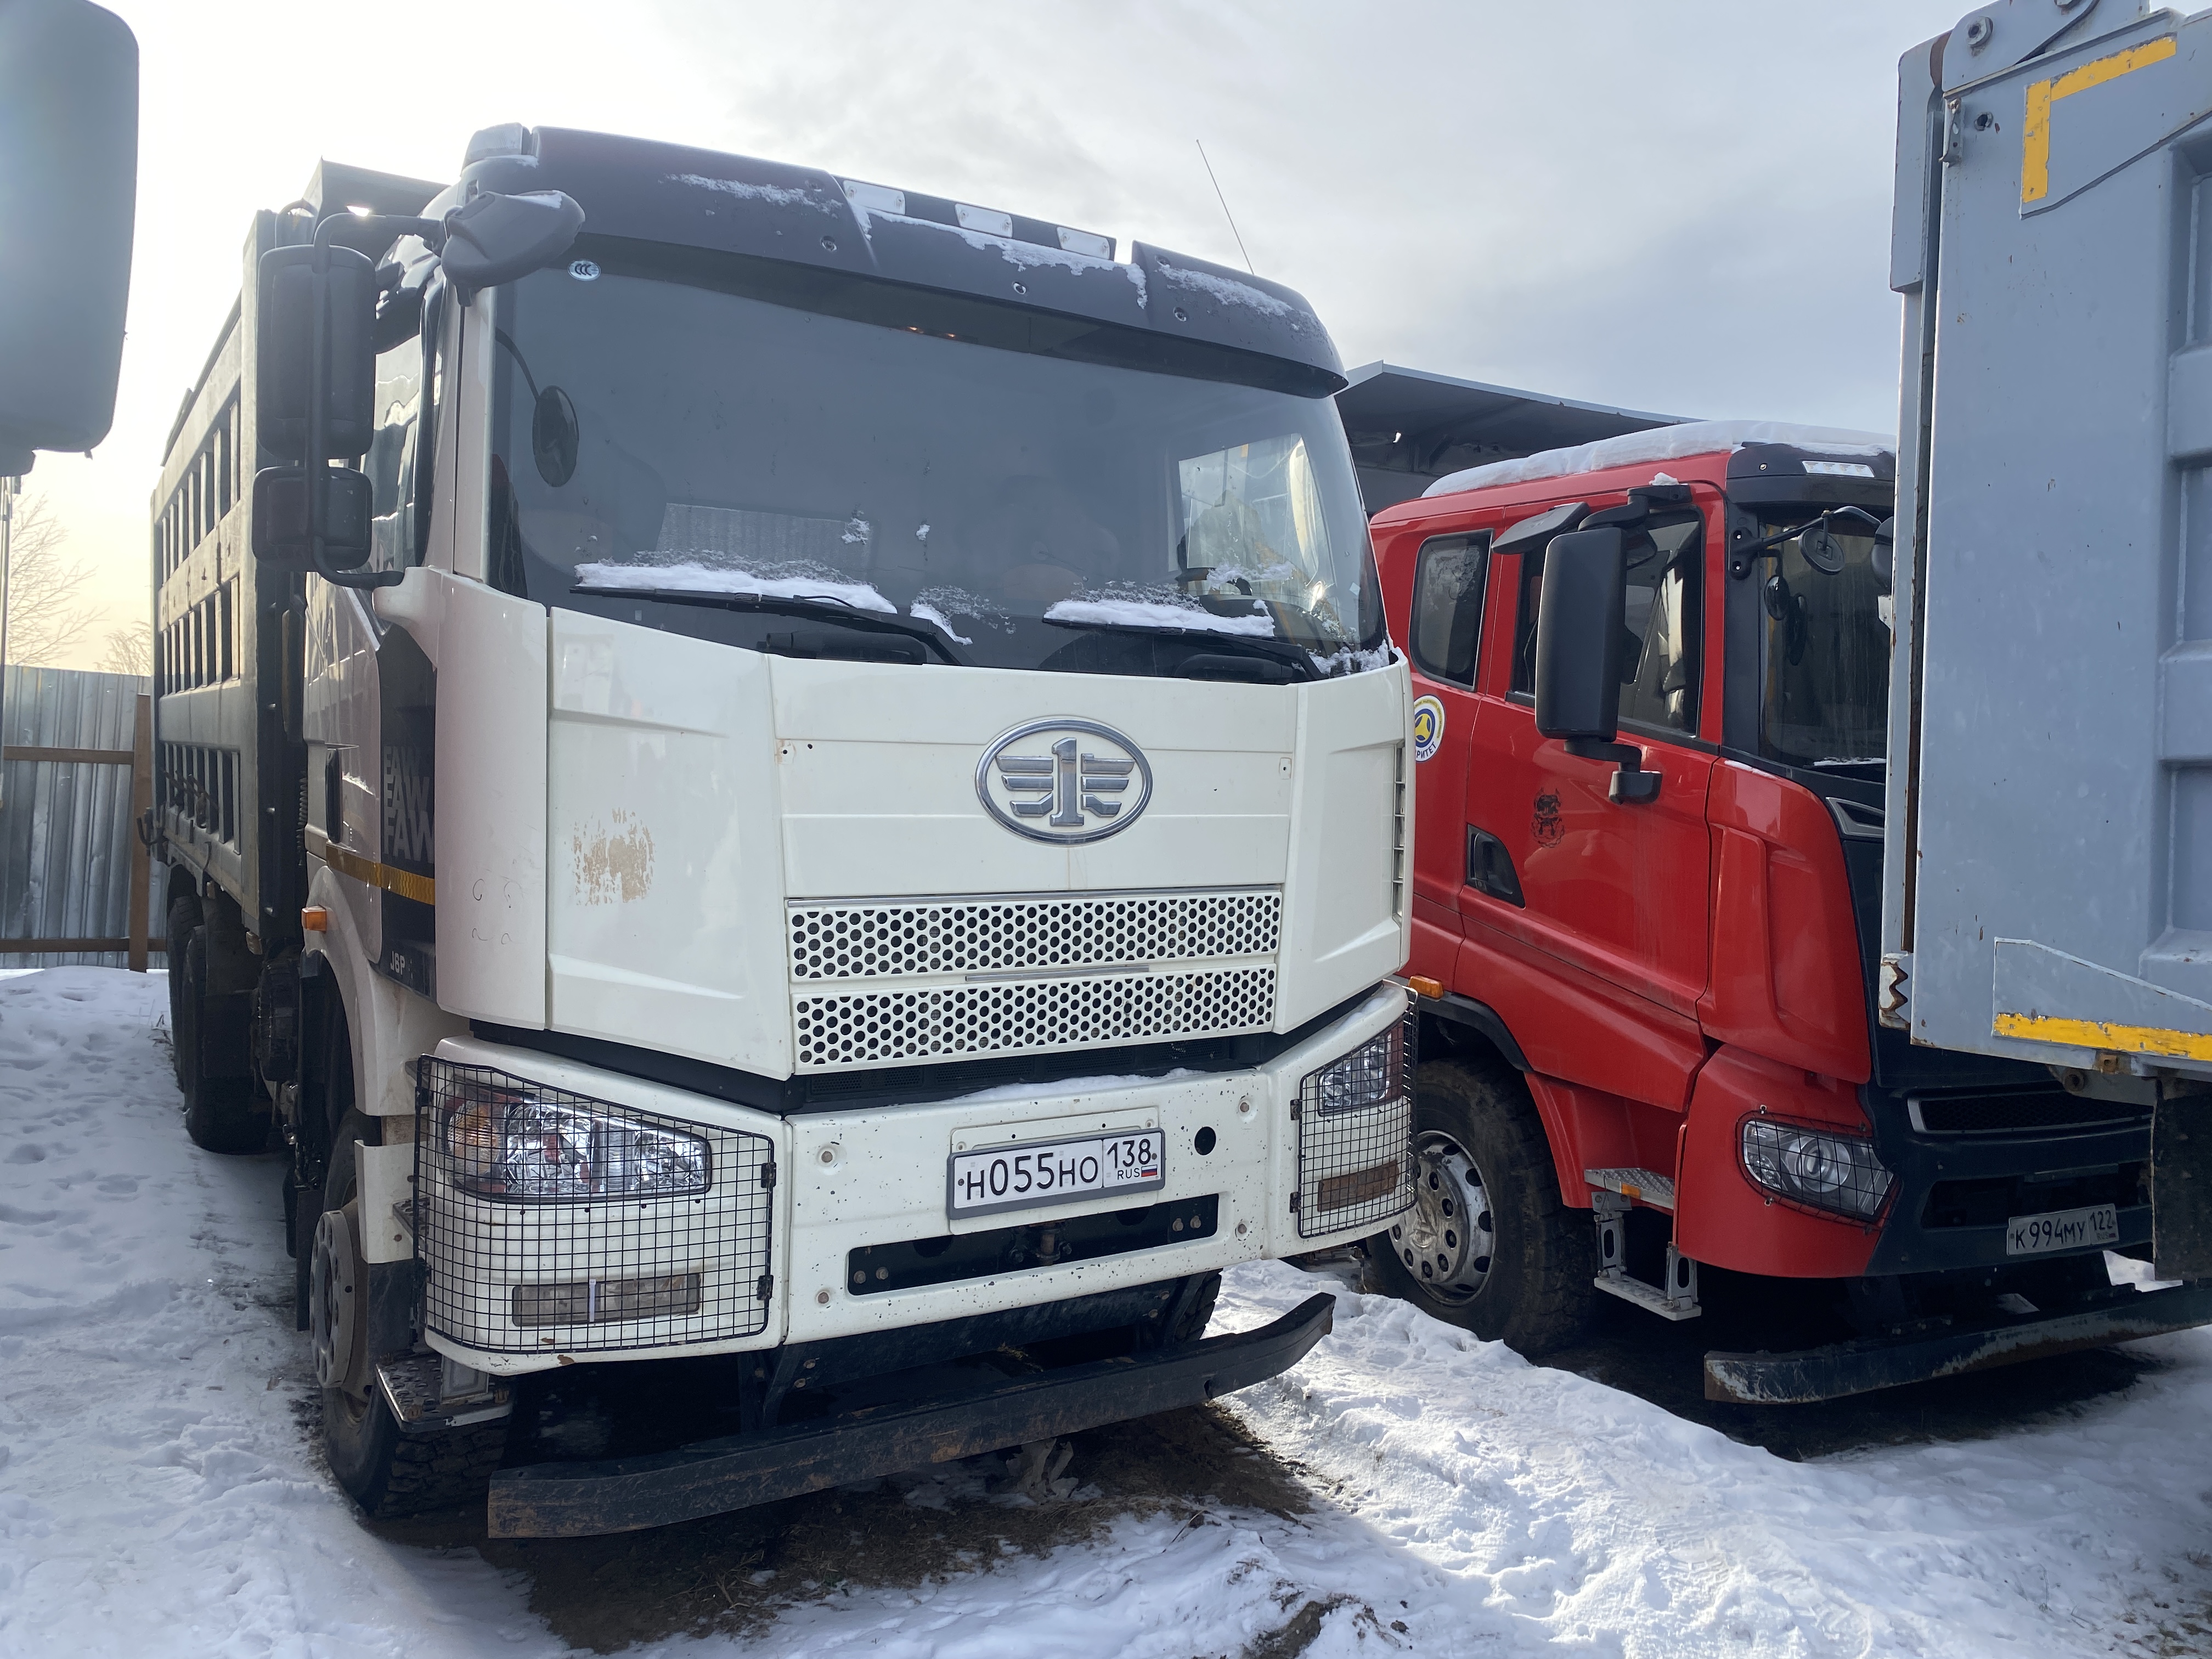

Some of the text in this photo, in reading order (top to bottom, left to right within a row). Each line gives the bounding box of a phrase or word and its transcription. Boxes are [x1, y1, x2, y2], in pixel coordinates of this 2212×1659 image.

[1416, 741, 1437, 759] РИТЕТ
[384, 775, 430, 811] FAW
[384, 806, 435, 863] FAW
[390, 950, 405, 975] J6P
[967, 1138, 1151, 1200] Н055НО 138
[1117, 1168, 1141, 1180] RUS
[2015, 1210, 2113, 1249] К994МУ 122
